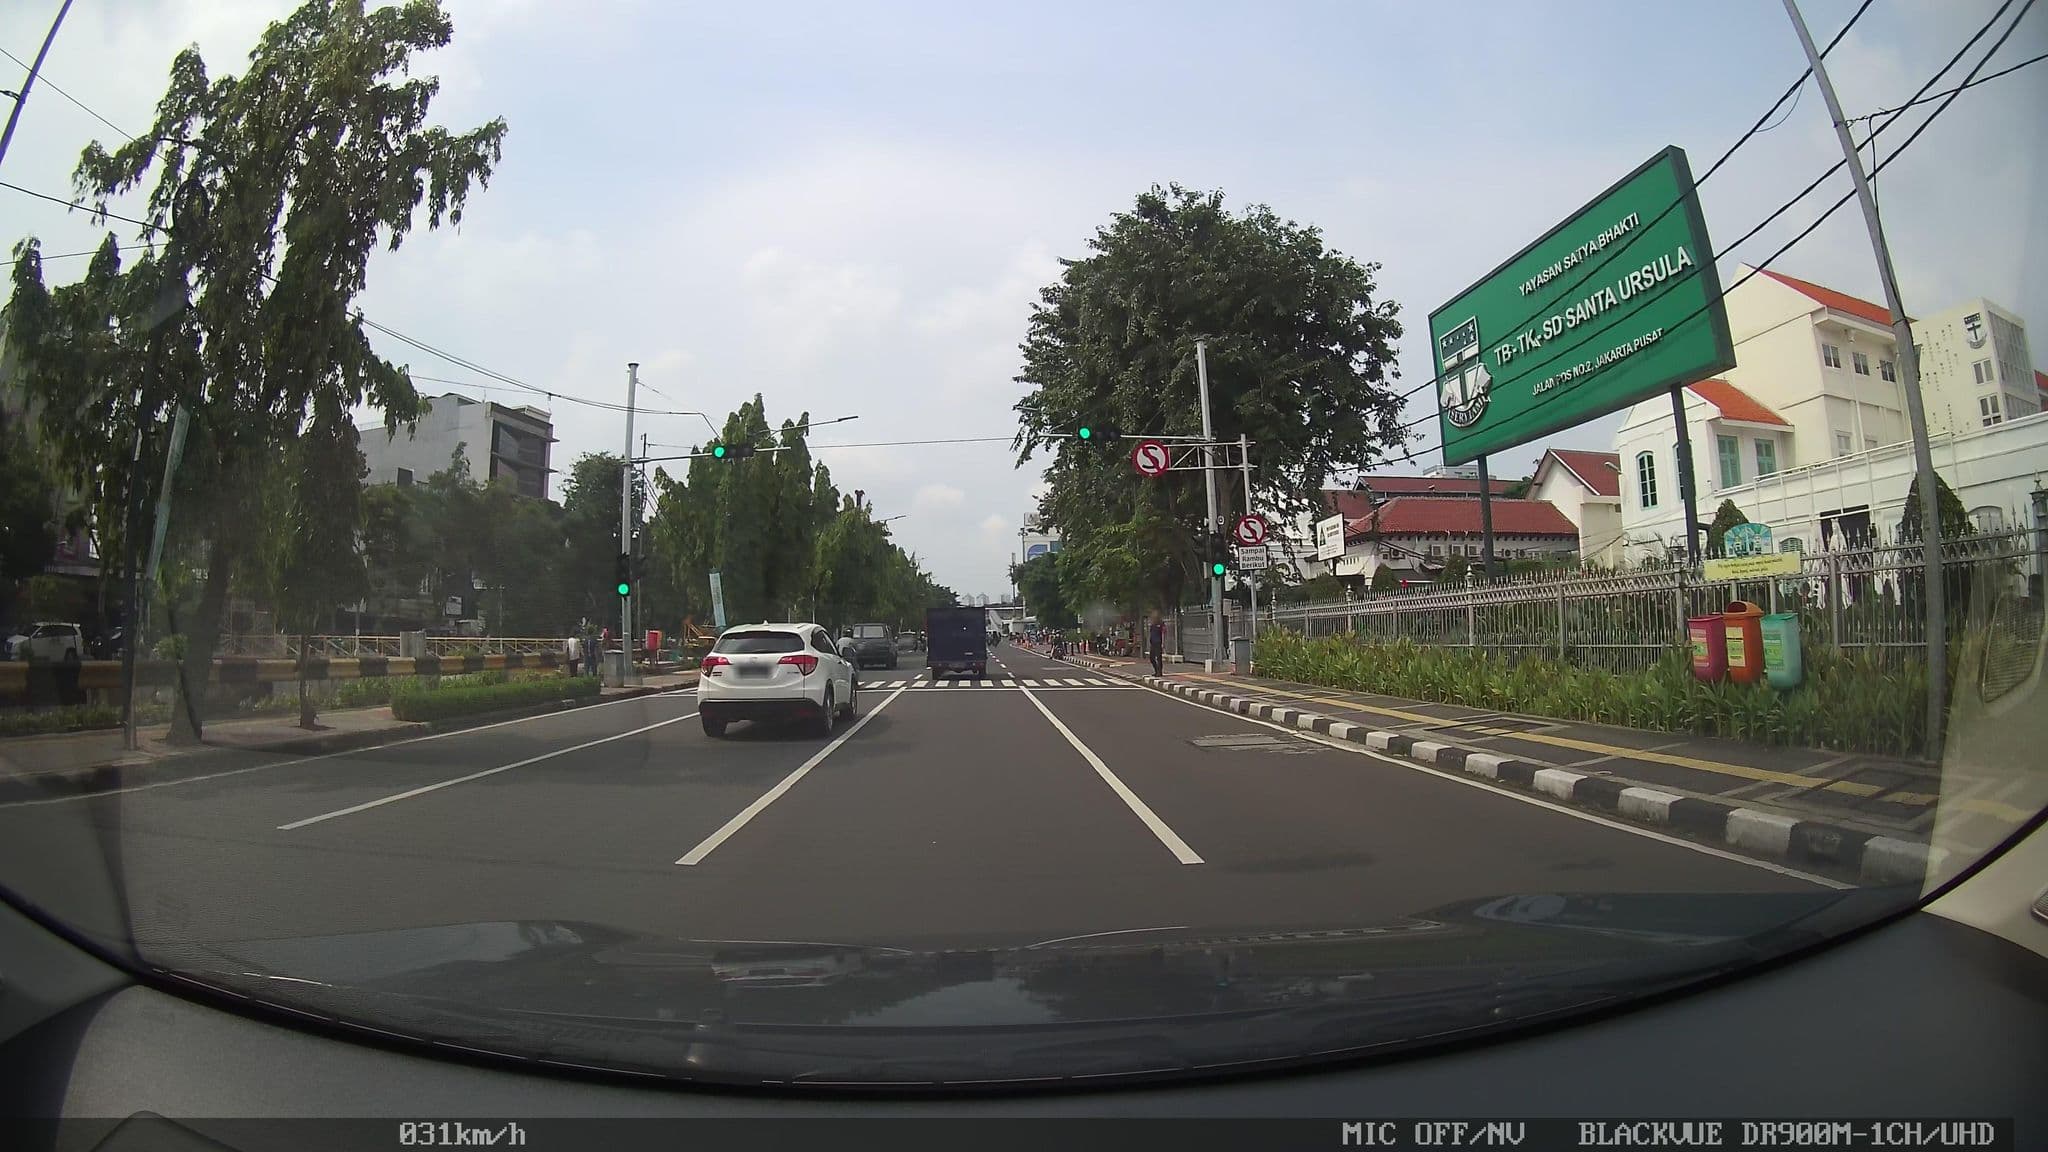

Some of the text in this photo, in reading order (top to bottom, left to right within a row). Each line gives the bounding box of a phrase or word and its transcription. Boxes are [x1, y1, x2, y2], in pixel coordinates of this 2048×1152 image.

[1519, 212, 1639, 296] YAYASAN SATYA BHAKTI
[1565, 286, 1618, 329] SANTA
[1618, 246, 1694, 300] URSULA
[1532, 378, 1554, 396] JALAN
[1595, 343, 1633, 368] JAKARTA
[1634, 328, 1663, 351] PUSAT
[1241, 547, 1265, 555] Sampai
